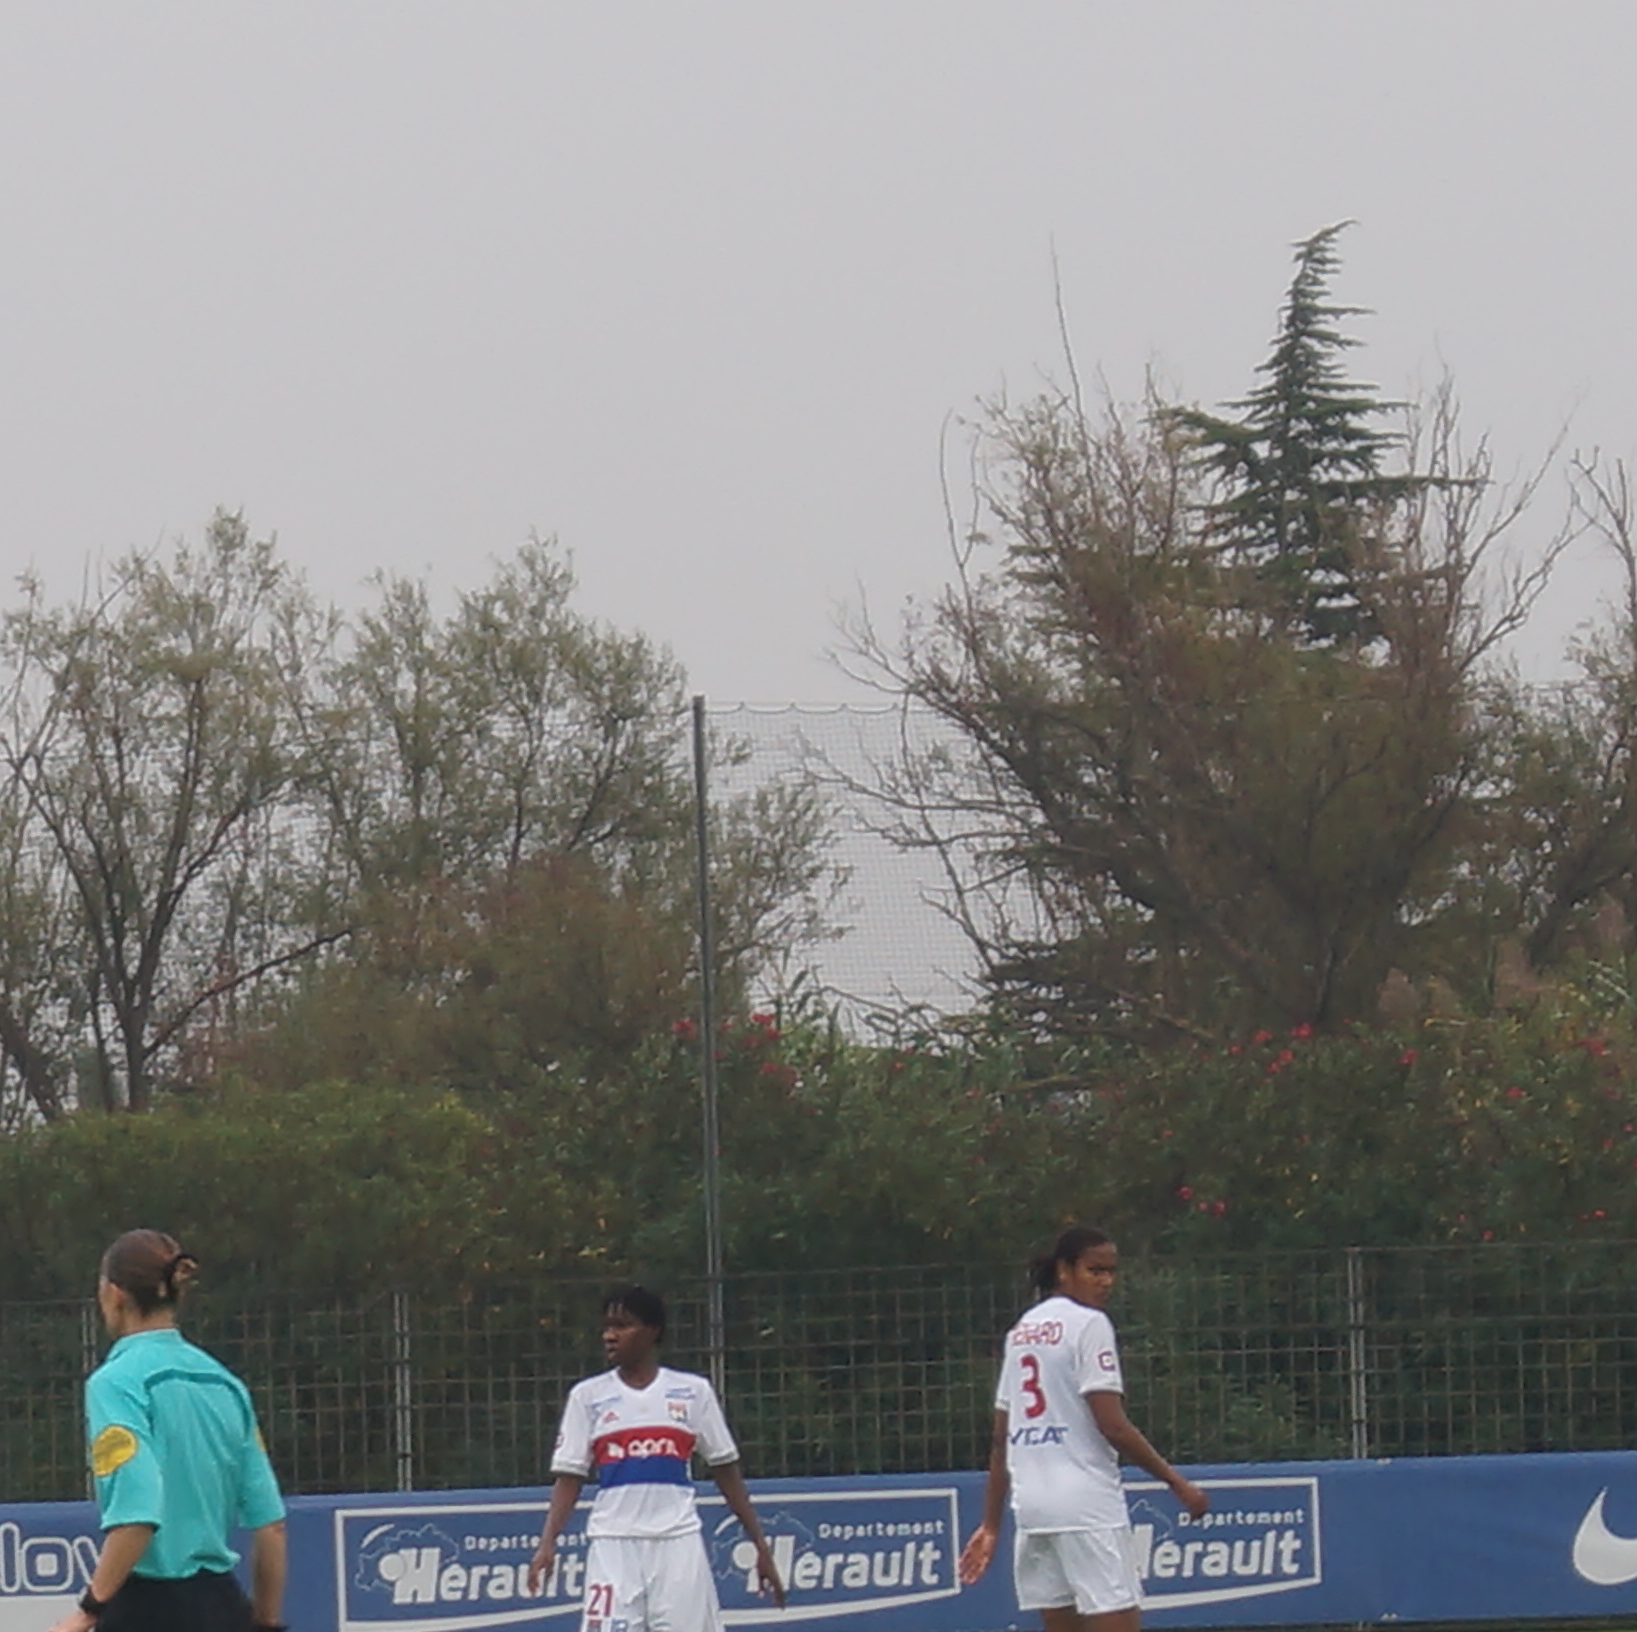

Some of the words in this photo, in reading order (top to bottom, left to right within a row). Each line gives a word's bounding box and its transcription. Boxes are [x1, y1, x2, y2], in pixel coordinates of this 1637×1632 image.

[1021, 1354, 1047, 1419] 3
[1178, 1508, 1305, 1530] Dpartement
[464, 1530, 587, 1552] Departeent
[586, 1583, 613, 1618] 21
